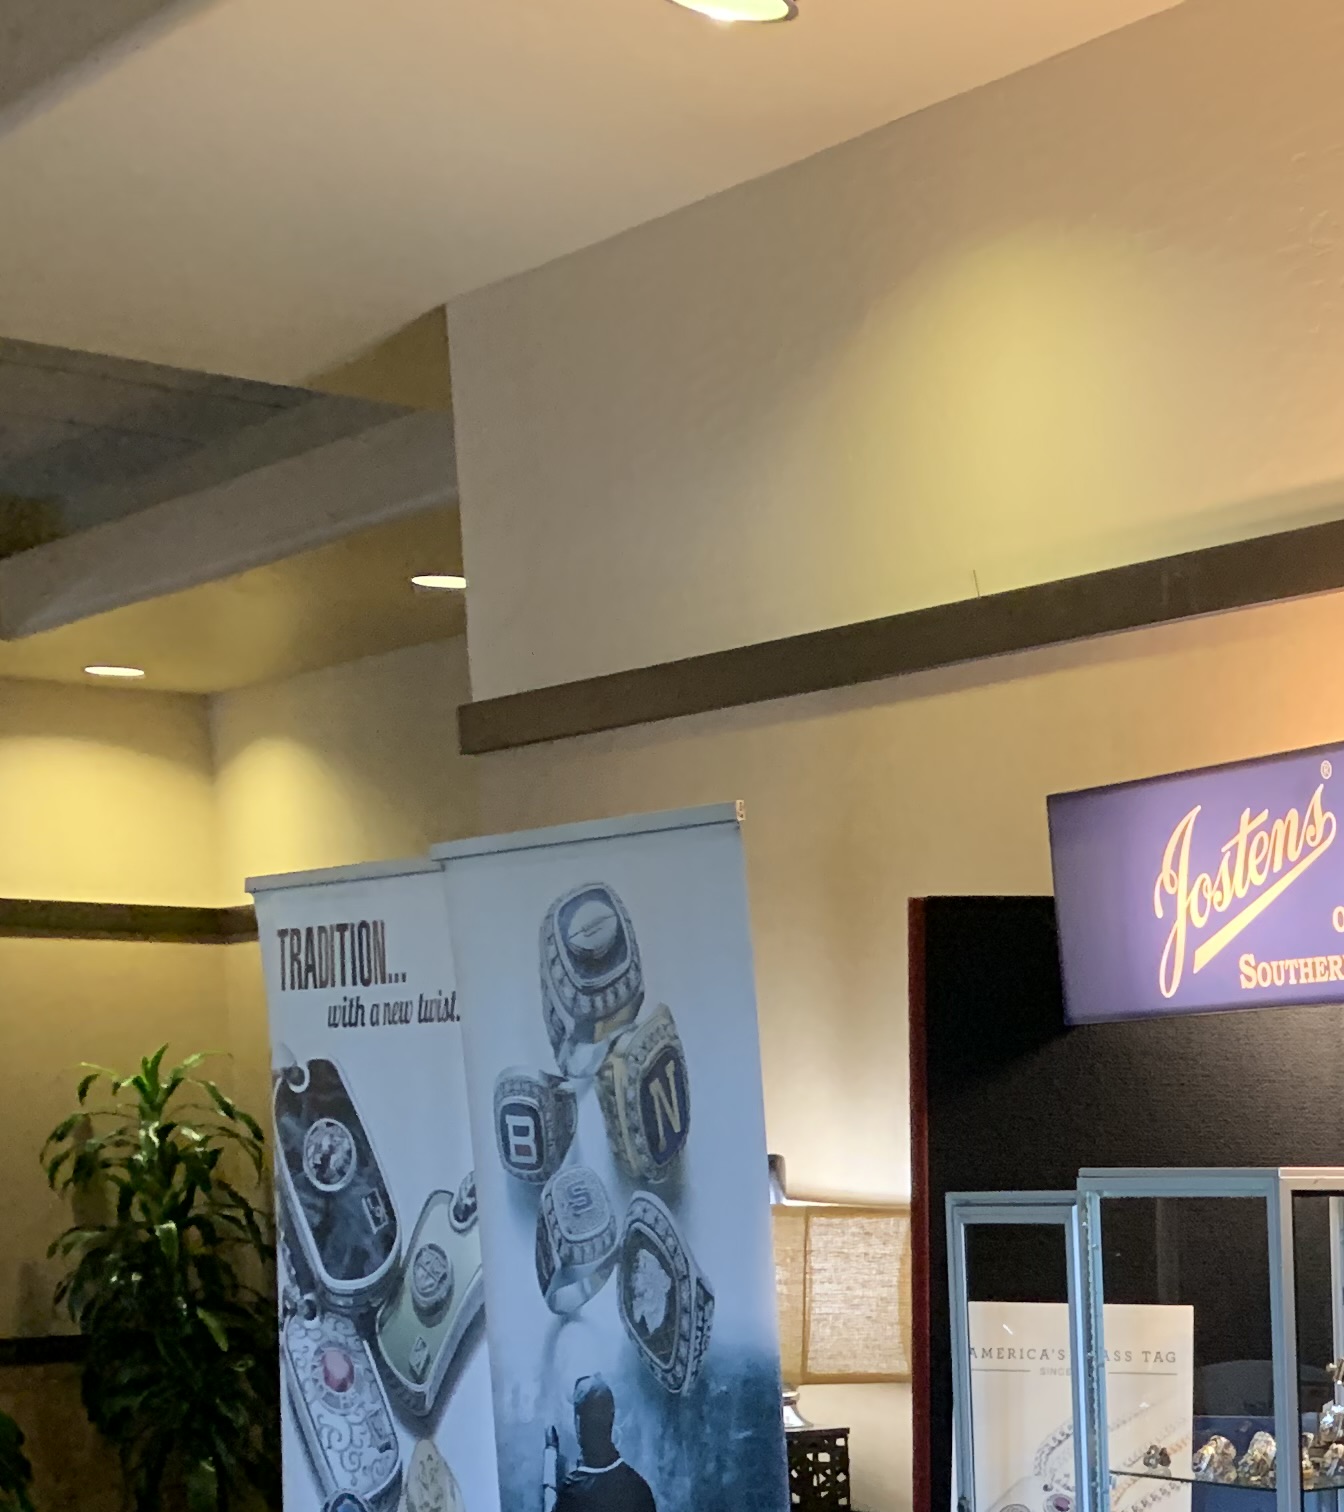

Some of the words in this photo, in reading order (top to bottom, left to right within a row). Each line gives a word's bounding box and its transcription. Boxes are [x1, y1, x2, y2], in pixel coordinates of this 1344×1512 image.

[277, 920, 407, 991] TRADITION...
[327, 996, 365, 1028] with
[370, 1004, 379, 1027] a
[383, 1000, 413, 1026] new
[418, 990, 461, 1025] twist.
[1142, 1351, 1177, 1364] TAG
